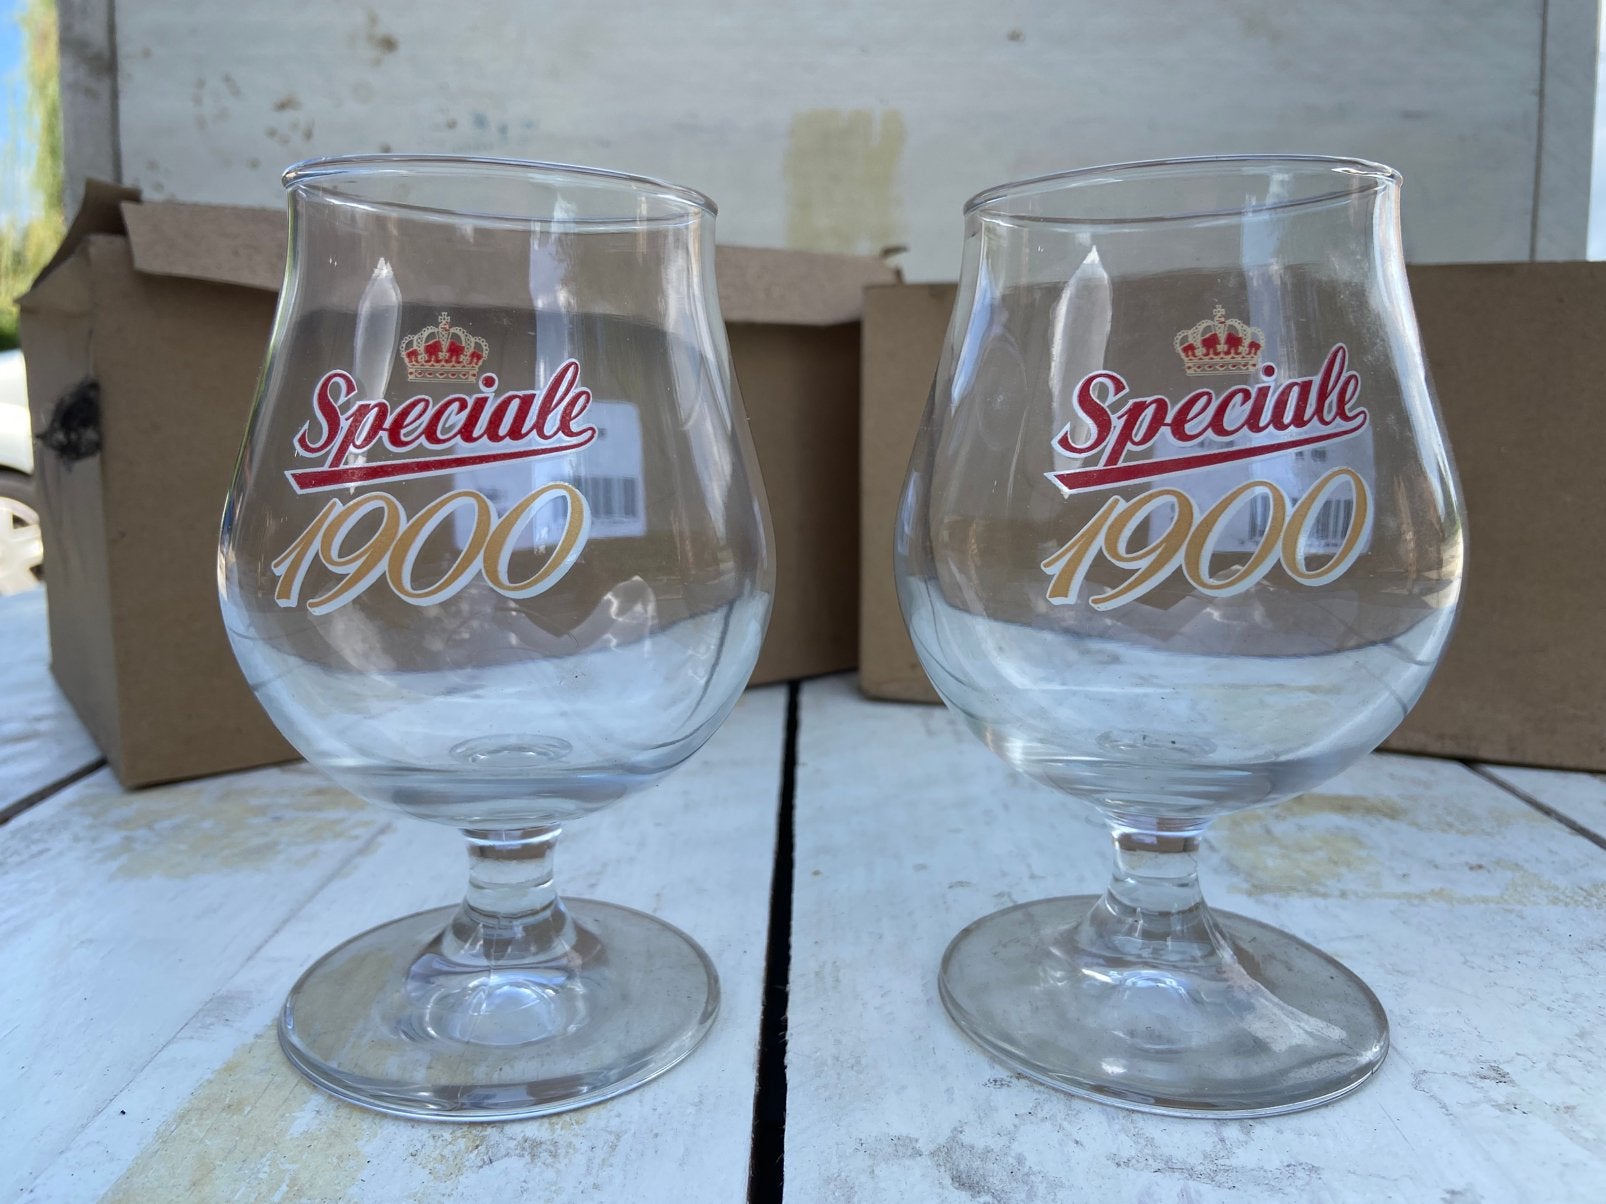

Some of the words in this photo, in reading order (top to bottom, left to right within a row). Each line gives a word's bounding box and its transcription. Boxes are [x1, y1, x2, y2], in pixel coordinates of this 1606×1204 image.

[292, 358, 597, 470] Speciale
[1051, 342, 1368, 468] Speciale
[271, 481, 592, 615] 1900
[1040, 466, 1372, 611] 1900
